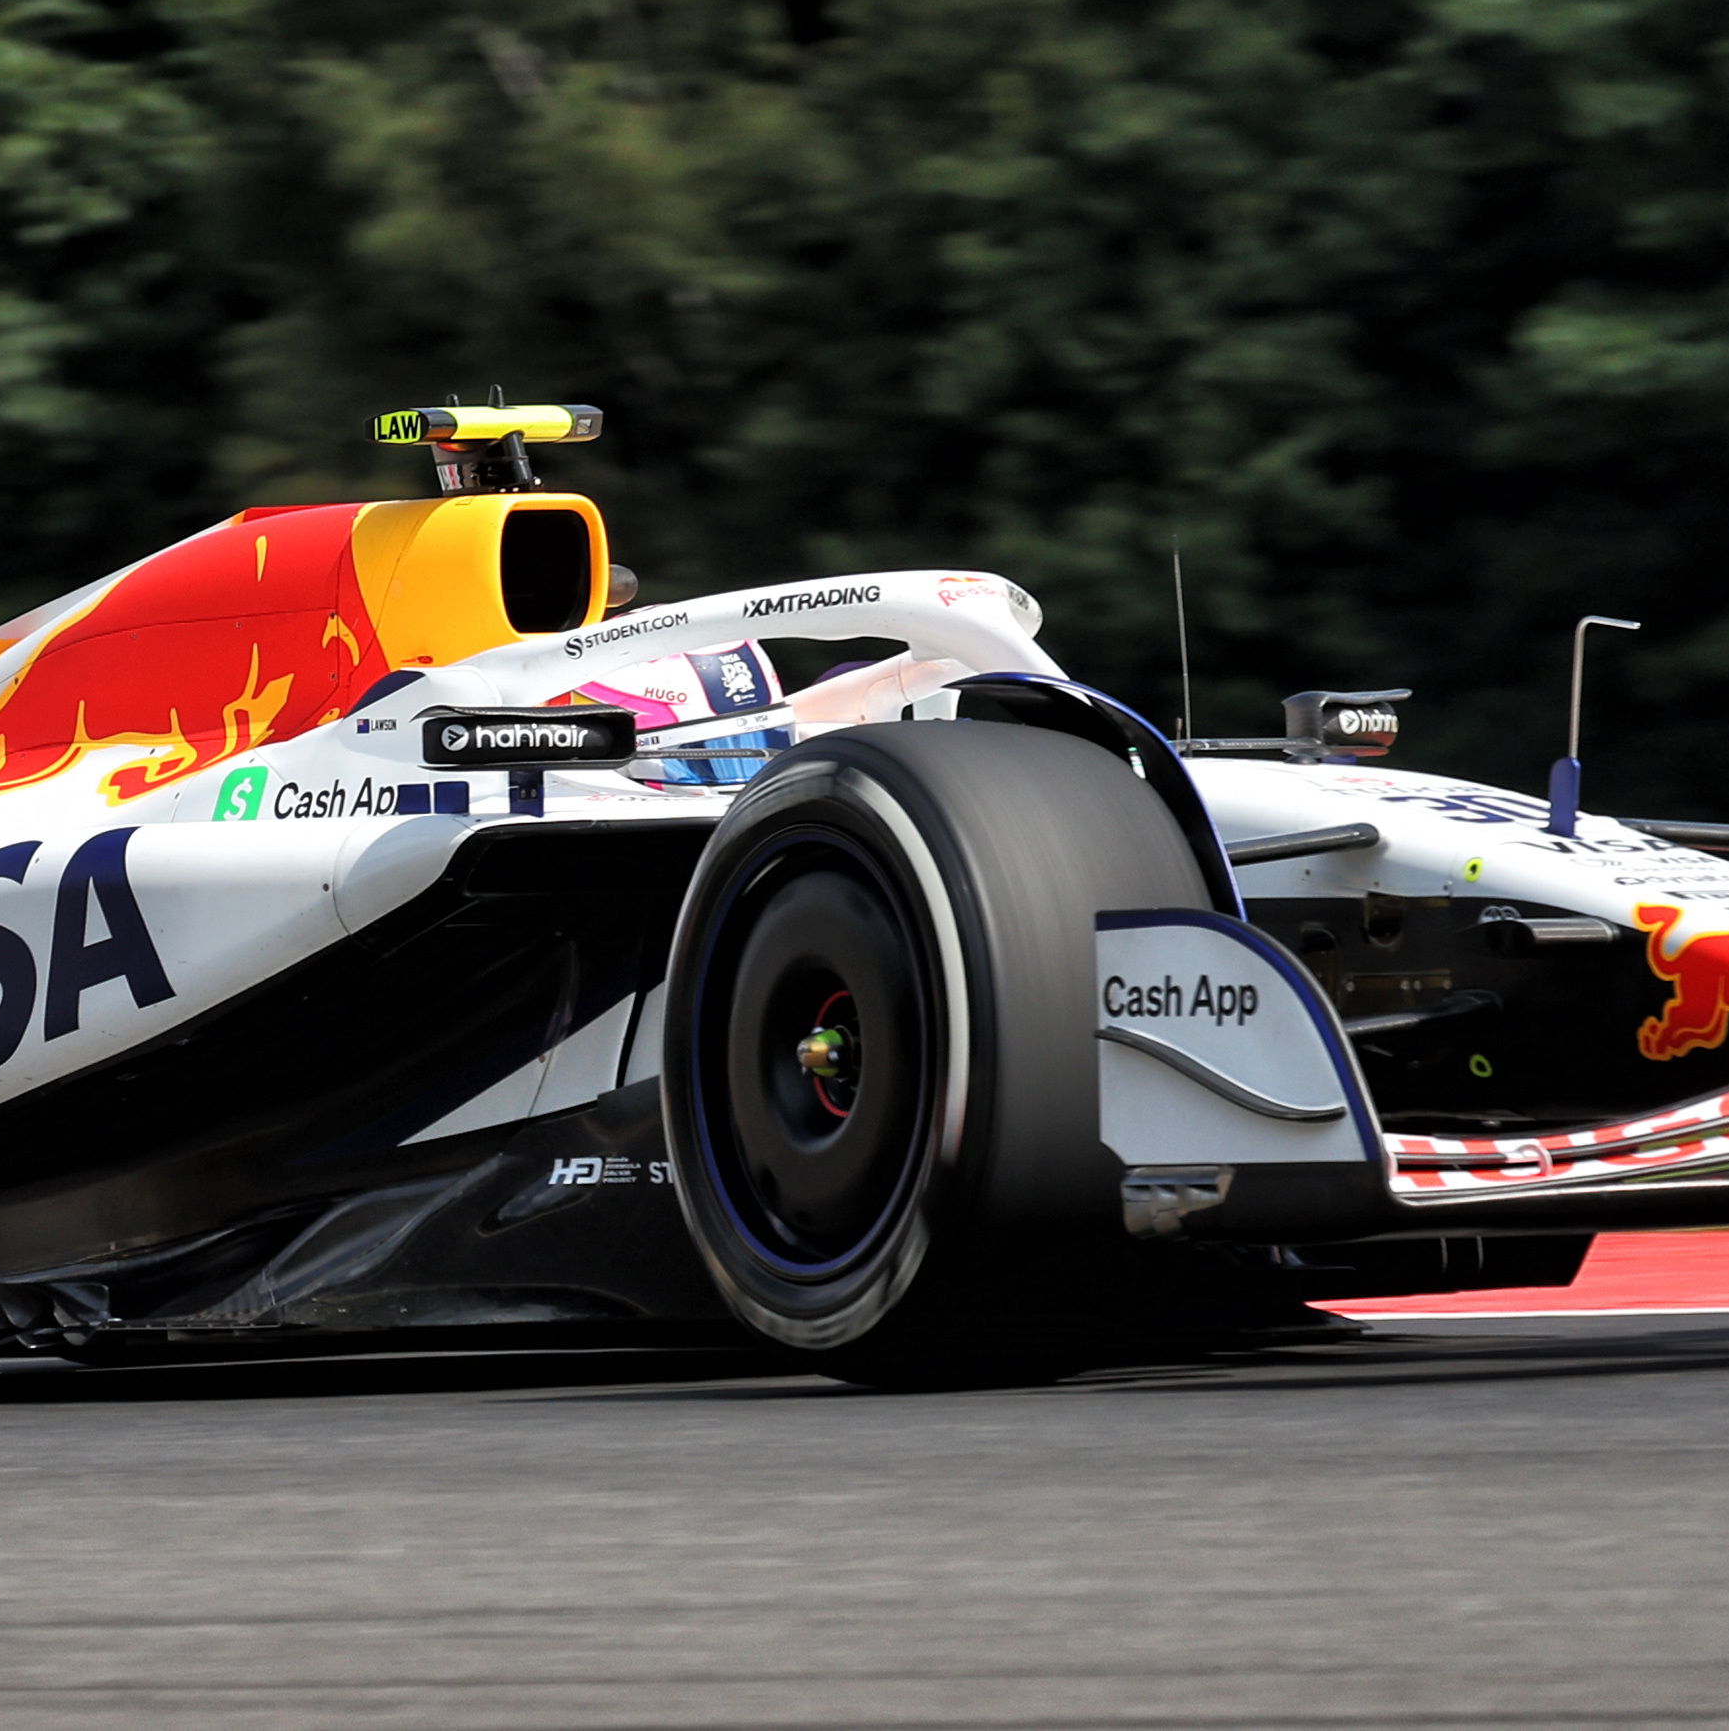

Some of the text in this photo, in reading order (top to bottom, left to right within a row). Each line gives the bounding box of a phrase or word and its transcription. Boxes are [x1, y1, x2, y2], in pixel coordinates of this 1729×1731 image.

[376, 415, 421, 440] LAW
[585, 611, 688, 649] STUDENT.COM
[644, 687, 688, 704] HUGO
[371, 719, 397, 731] LAWSON
[475, 724, 589, 749] hahnair
[274, 779, 346, 820] Cash
[351, 777, 399, 818] Ap
[1104, 974, 1259, 1027] Cash App
[649, 1162, 674, 1184] ST
